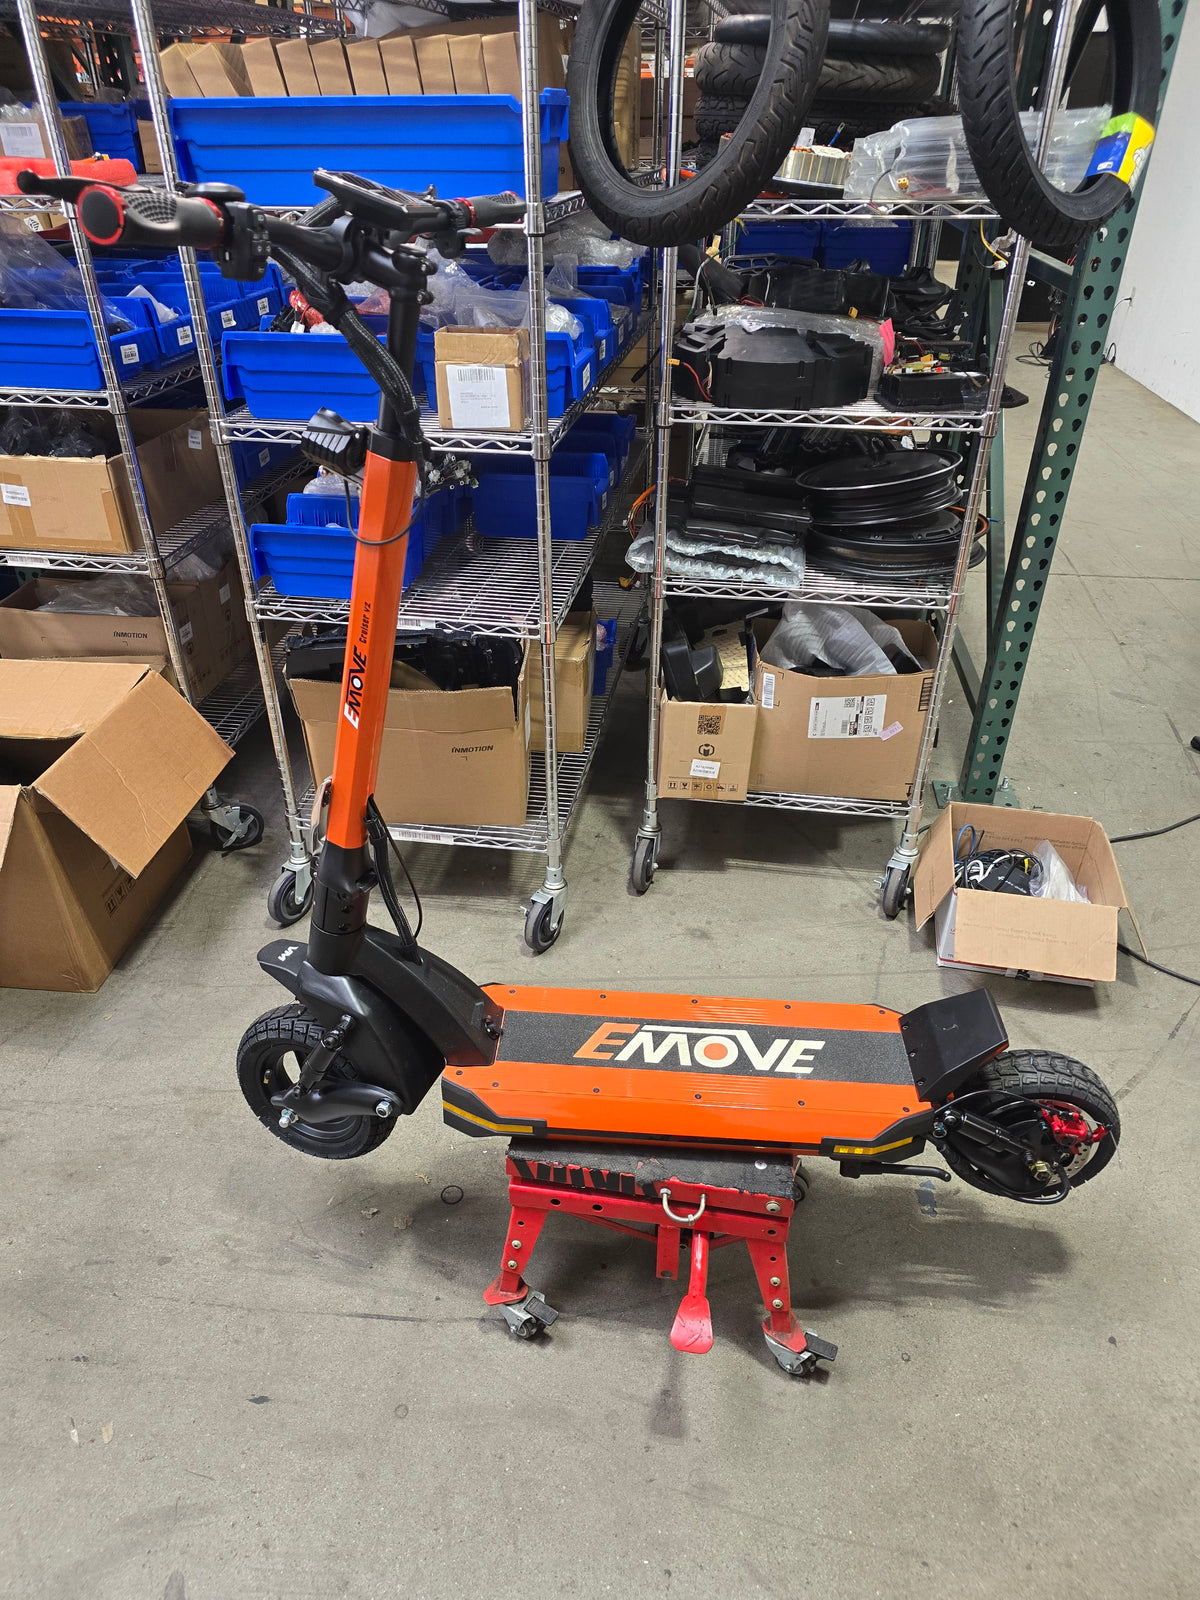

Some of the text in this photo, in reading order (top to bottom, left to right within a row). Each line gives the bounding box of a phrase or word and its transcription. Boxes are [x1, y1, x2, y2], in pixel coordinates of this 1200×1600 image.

[343, 645, 367, 730] EMOVE
[359, 613, 370, 644] Cruiser
[572, 1022, 826, 1074] EMOVE
